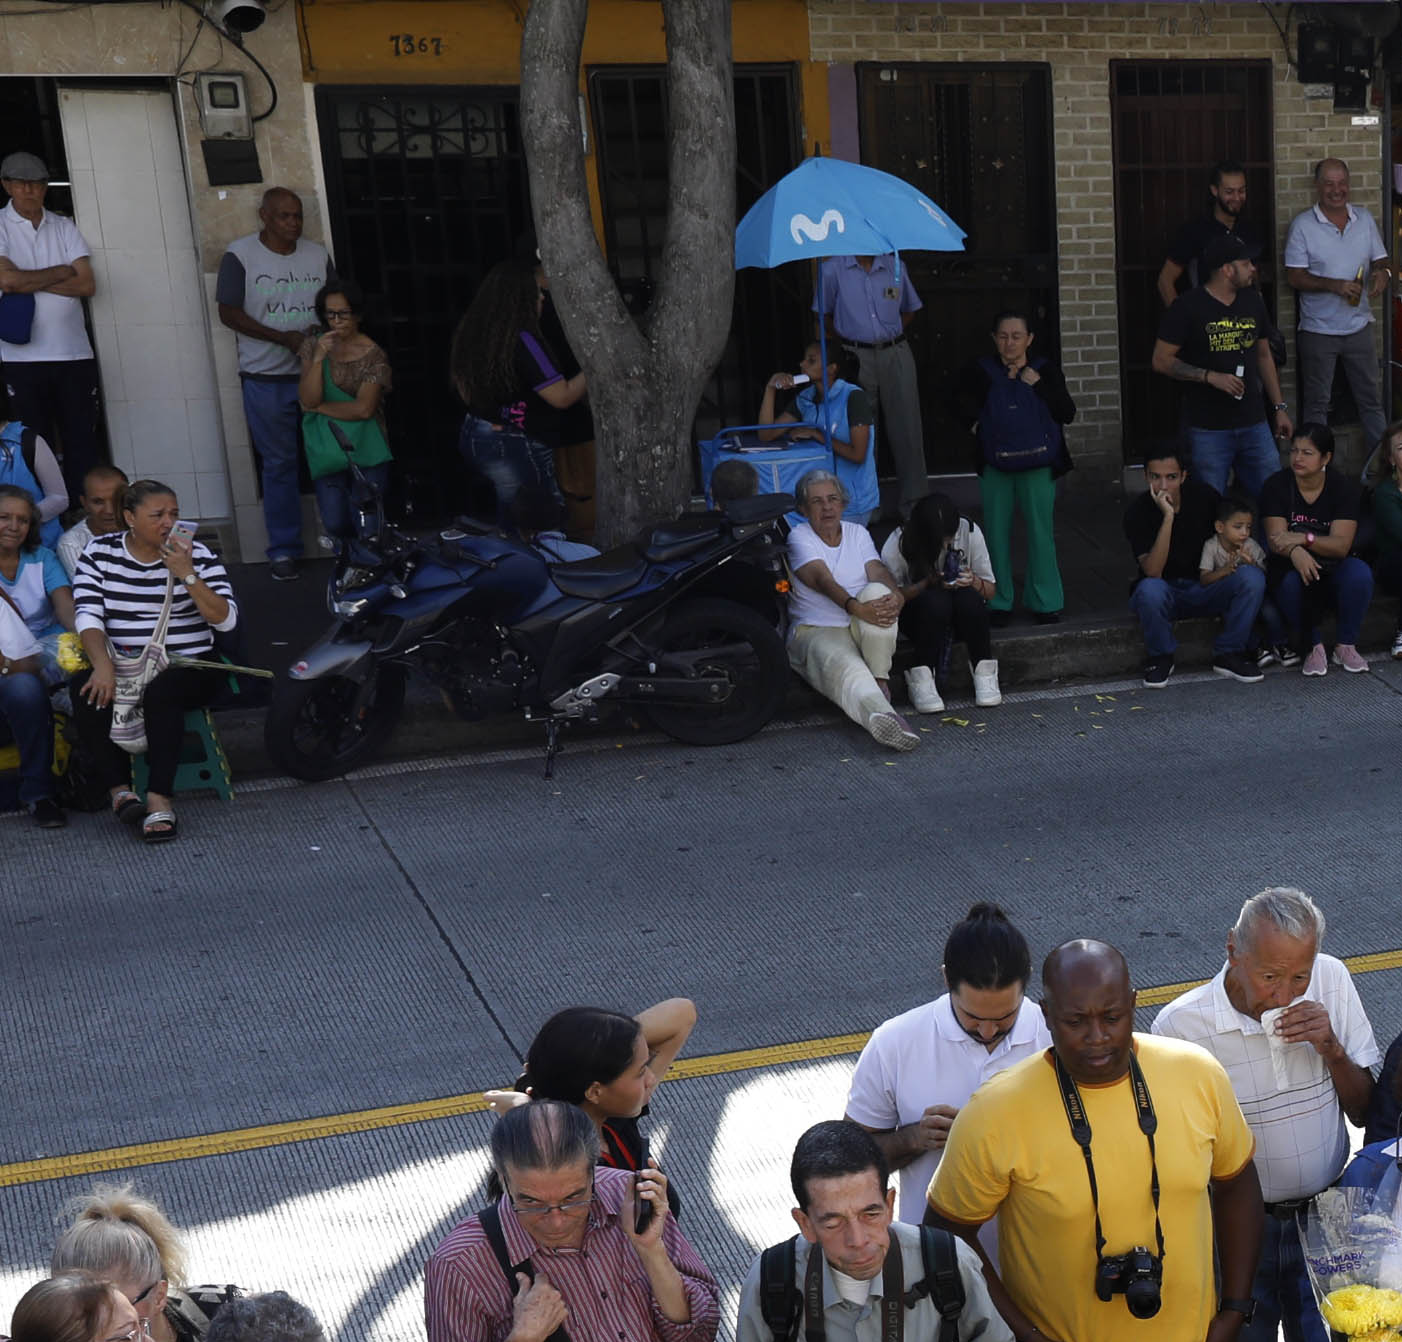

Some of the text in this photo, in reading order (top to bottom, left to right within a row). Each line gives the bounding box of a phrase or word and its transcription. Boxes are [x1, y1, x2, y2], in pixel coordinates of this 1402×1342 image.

[1137, 1081, 1149, 1108] Nikon
[1068, 1093, 1083, 1120] Nikon
[1307, 1251, 1366, 1267] NCHMARK
[1314, 1261, 1362, 1276] OWERS
